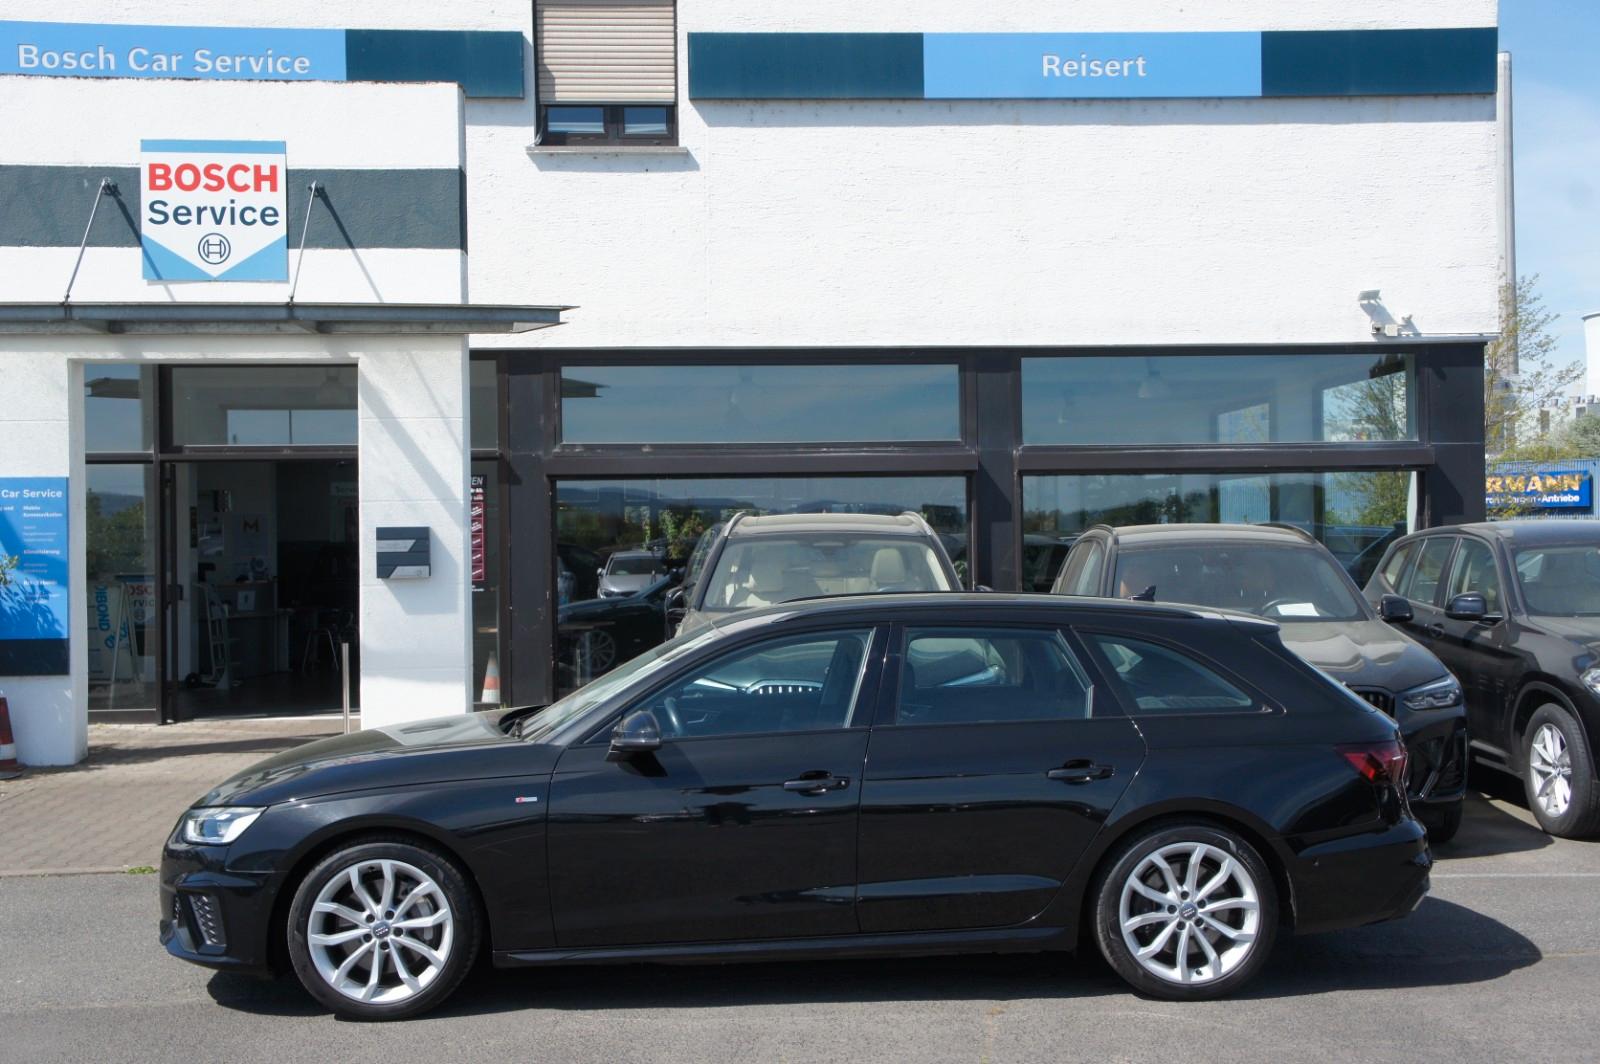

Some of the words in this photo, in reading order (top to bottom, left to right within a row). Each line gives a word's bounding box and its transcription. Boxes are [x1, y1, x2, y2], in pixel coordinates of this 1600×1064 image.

[17, 43, 116, 71] Bosch
[127, 47, 183, 73] Car
[193, 48, 311, 74] Service
[1042, 53, 1147, 78] Reisert
[148, 162, 278, 193] BOSCH
[148, 198, 280, 227] Service
[471, 476, 484, 486] EN
[1486, 474, 1583, 493] RMANN
[1, 489, 21, 498] Car
[23, 488, 63, 498] Service
[1542, 494, 1580, 502] Antriebe
